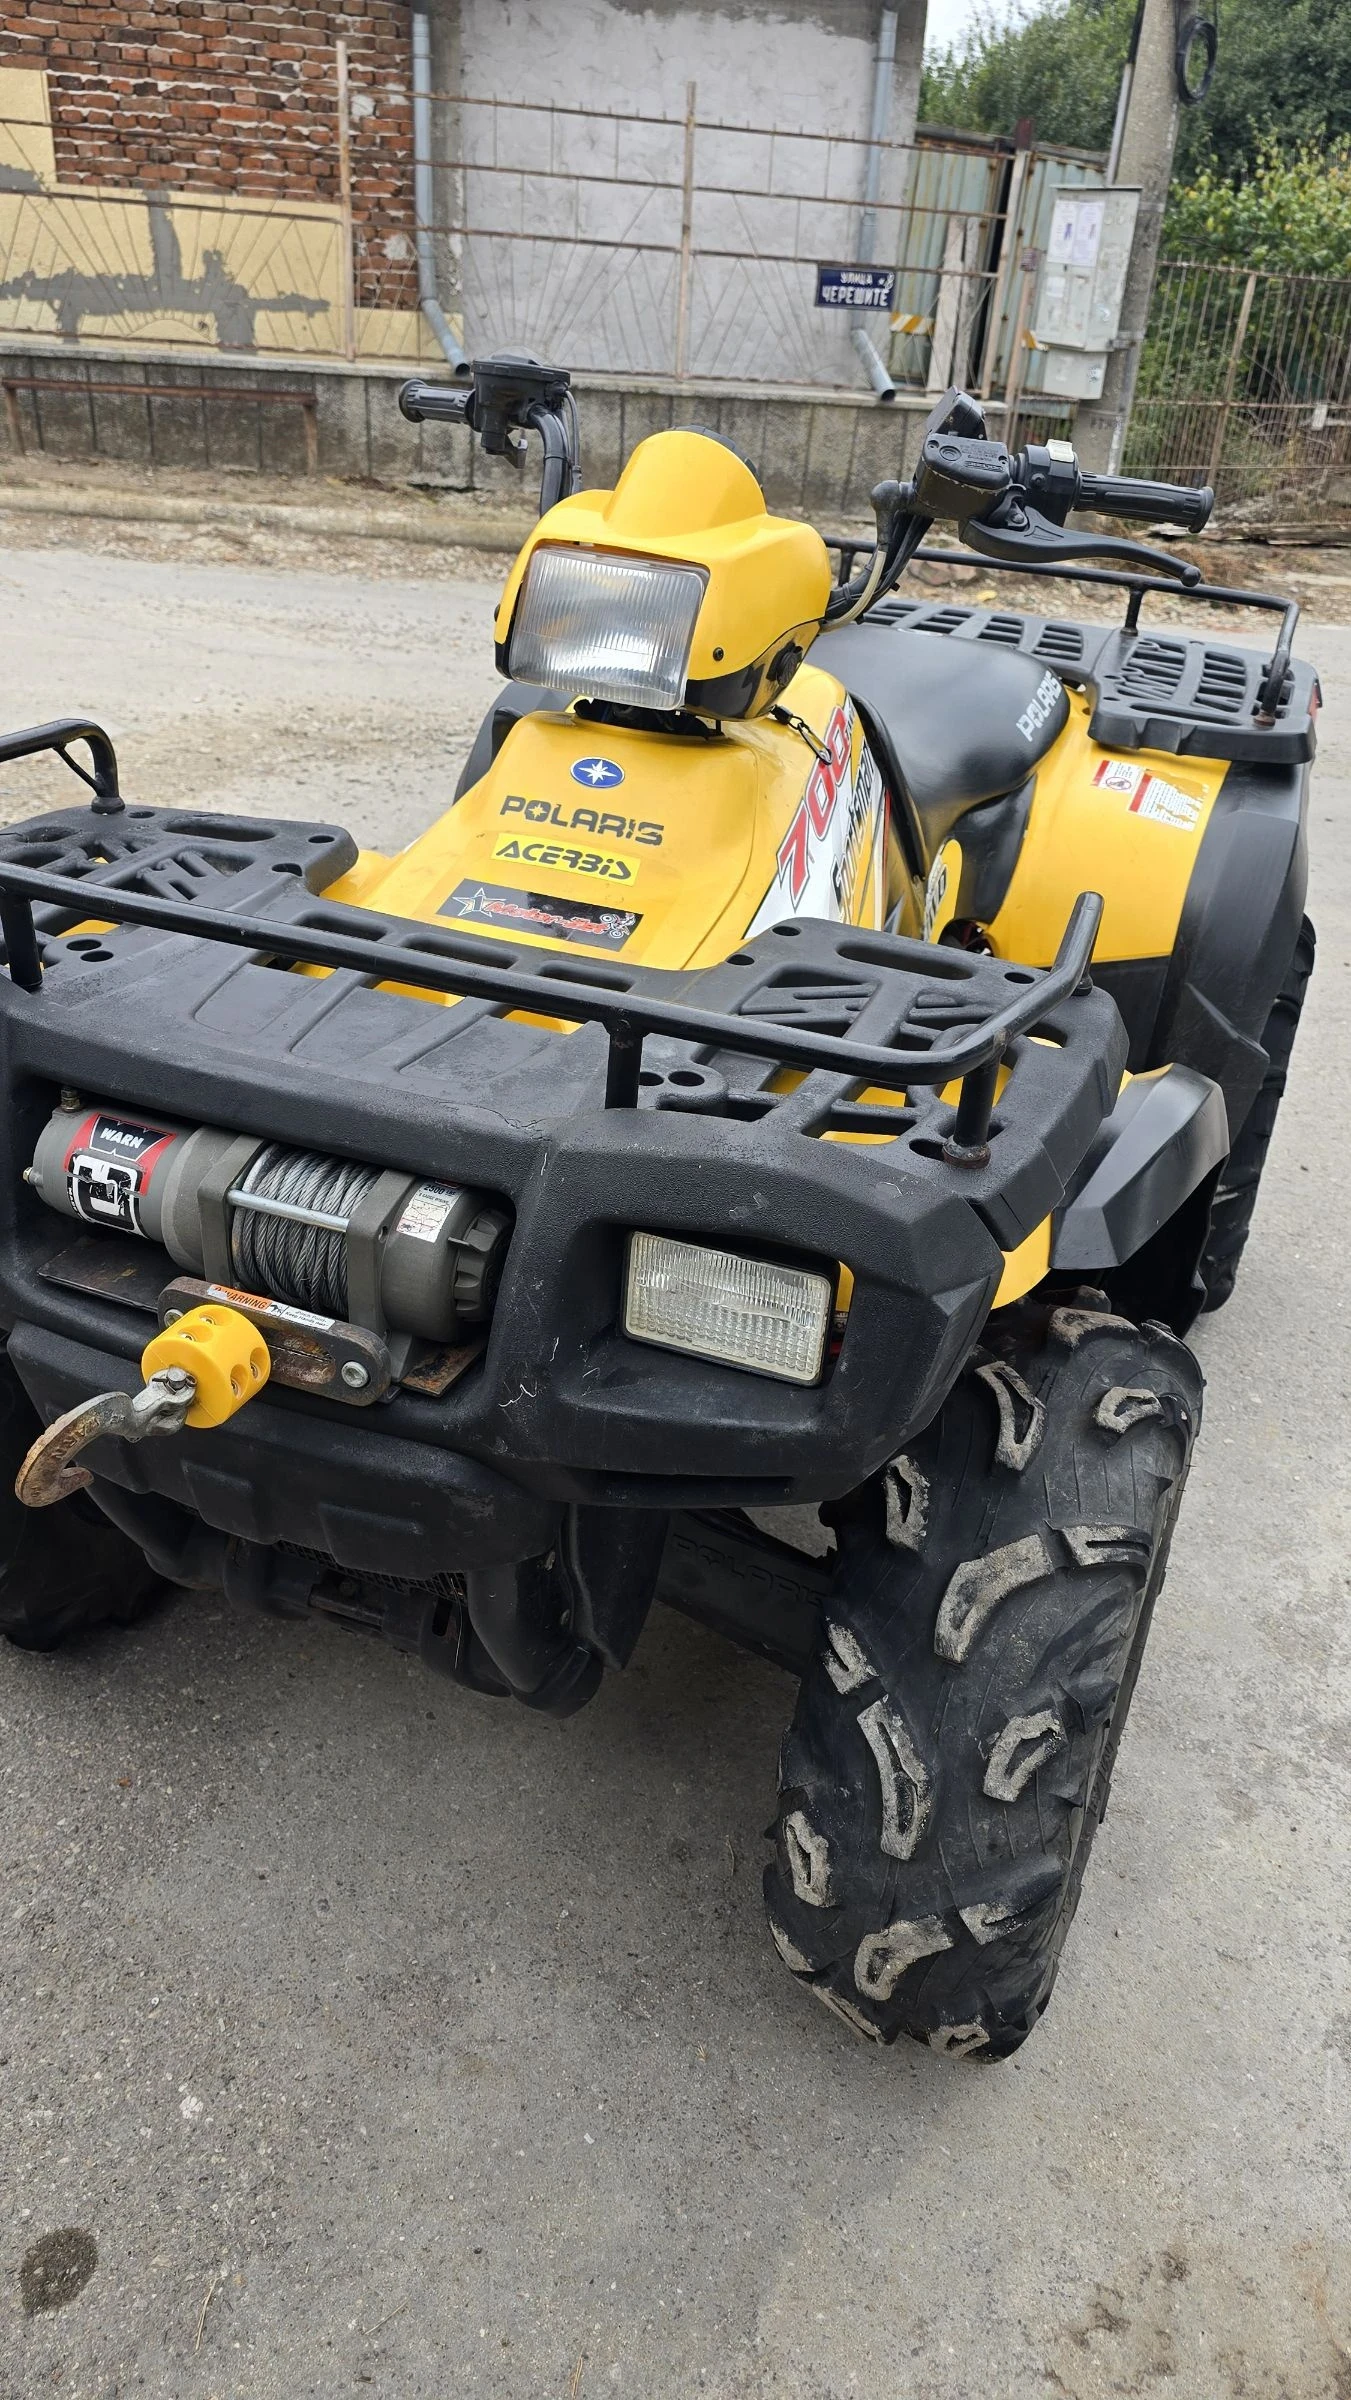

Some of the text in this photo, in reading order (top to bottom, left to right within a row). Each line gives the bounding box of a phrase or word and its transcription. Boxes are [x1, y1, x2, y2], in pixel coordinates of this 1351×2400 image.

[840, 271, 873, 286] УЛИЦА
[821, 285, 890, 307] ЧЕРЕШИТЕ
[1015, 670, 1063, 743] POLARIS
[775, 704, 851, 914] 700
[500, 795, 665, 846] POLARIS
[99, 1127, 145, 1149] WARN
[423, 1183, 446, 1195] 2500
[224, 1290, 268, 1310] WARNING
[672, 1533, 829, 1609] POLARIS
